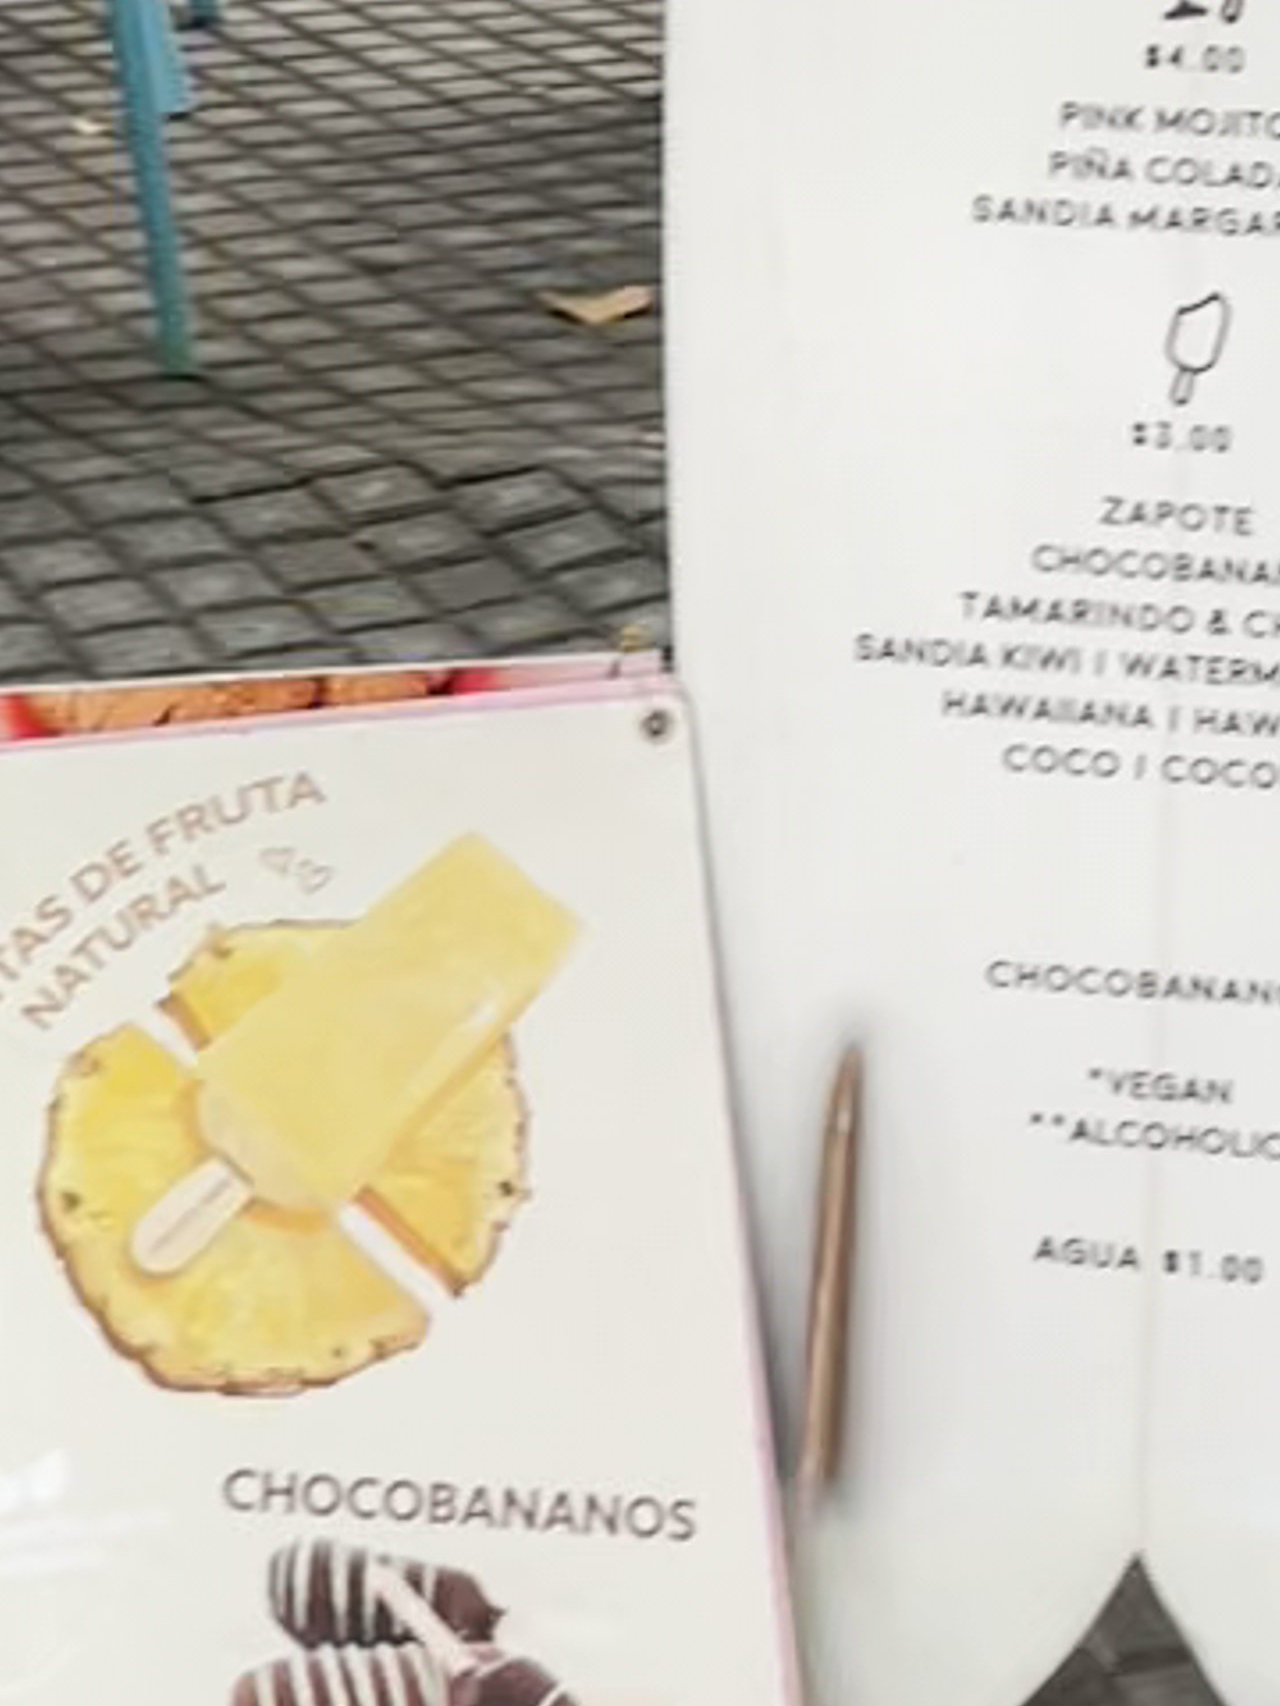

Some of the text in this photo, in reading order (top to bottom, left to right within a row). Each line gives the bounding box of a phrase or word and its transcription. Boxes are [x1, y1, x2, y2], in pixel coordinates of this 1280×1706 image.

[1144, 42, 1246, 74] $4.00
[1058, 100, 1145, 133] PINK
[1048, 145, 1134, 182] PIÑA
[970, 192, 1116, 228] SANDIA
[1100, 495, 1255, 538] ZAPOTE
[958, 590, 1195, 635] TAMARINDO
[1206, 607, 1231, 636] &
[854, 632, 990, 669] SANDIA
[999, 641, 1083, 676] KIWI
[1002, 742, 1121, 779] COCO
[68, 840, 143, 915] DE
[145, 767, 332, 866] FRUTA
[18, 862, 229, 1034] NATURAL
[1033, 1235, 1266, 1285] AGUA $1.00
[221, 1466, 699, 1543] CHOCOBANANOS
